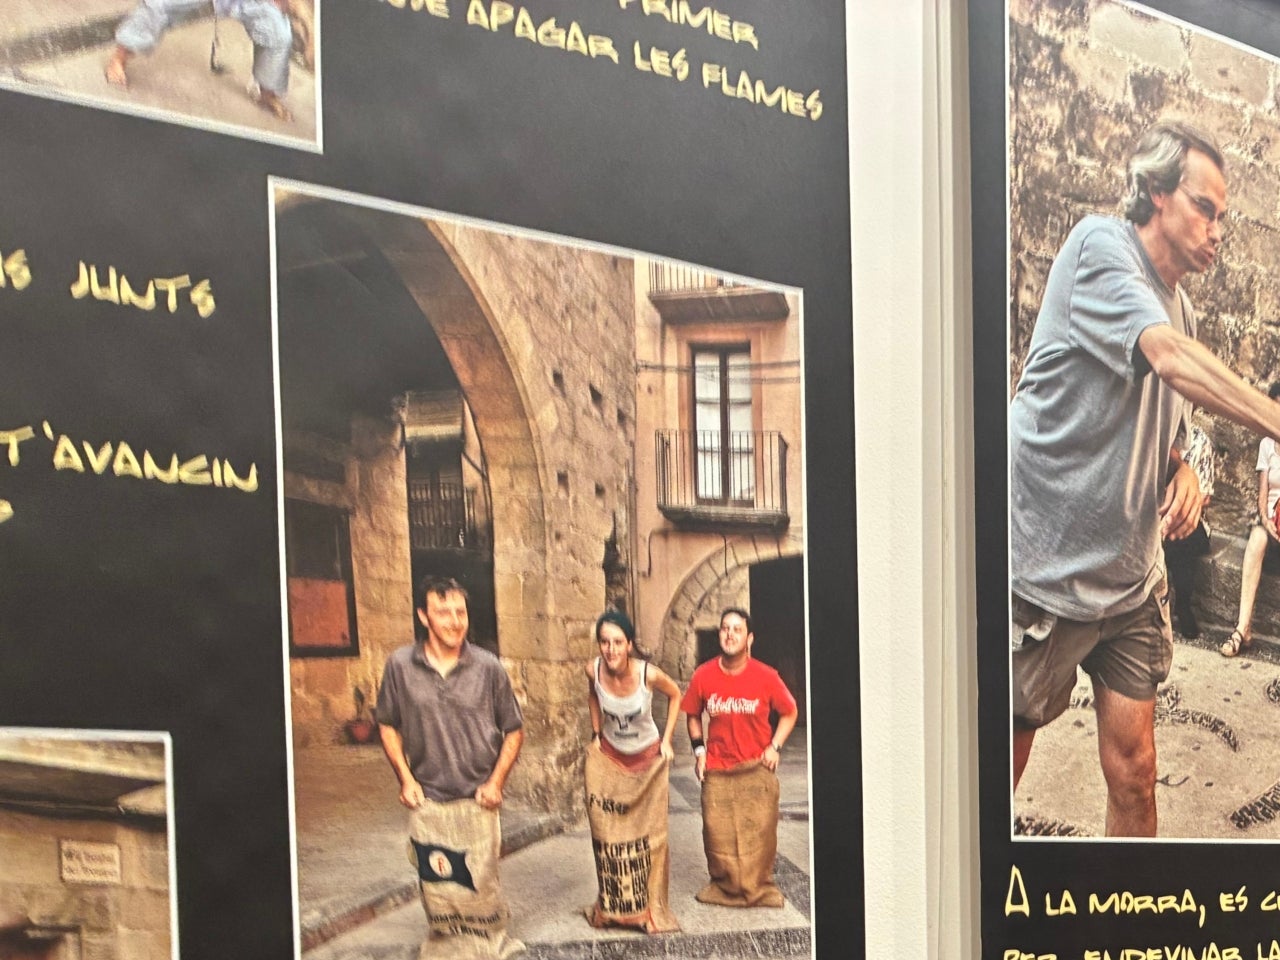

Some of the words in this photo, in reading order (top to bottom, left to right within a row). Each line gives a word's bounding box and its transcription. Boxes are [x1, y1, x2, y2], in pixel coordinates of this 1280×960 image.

[466, 0, 619, 64] APAGAR
[633, 40, 689, 82] LES
[702, 62, 823, 121] FLAMES
[70, 260, 216, 318] JUNTS
[1004, 864, 1030, 917] A
[1045, 889, 1077, 916] LA
[1088, 888, 1206, 929] MORRA,
[1219, 885, 1249, 913] ES
